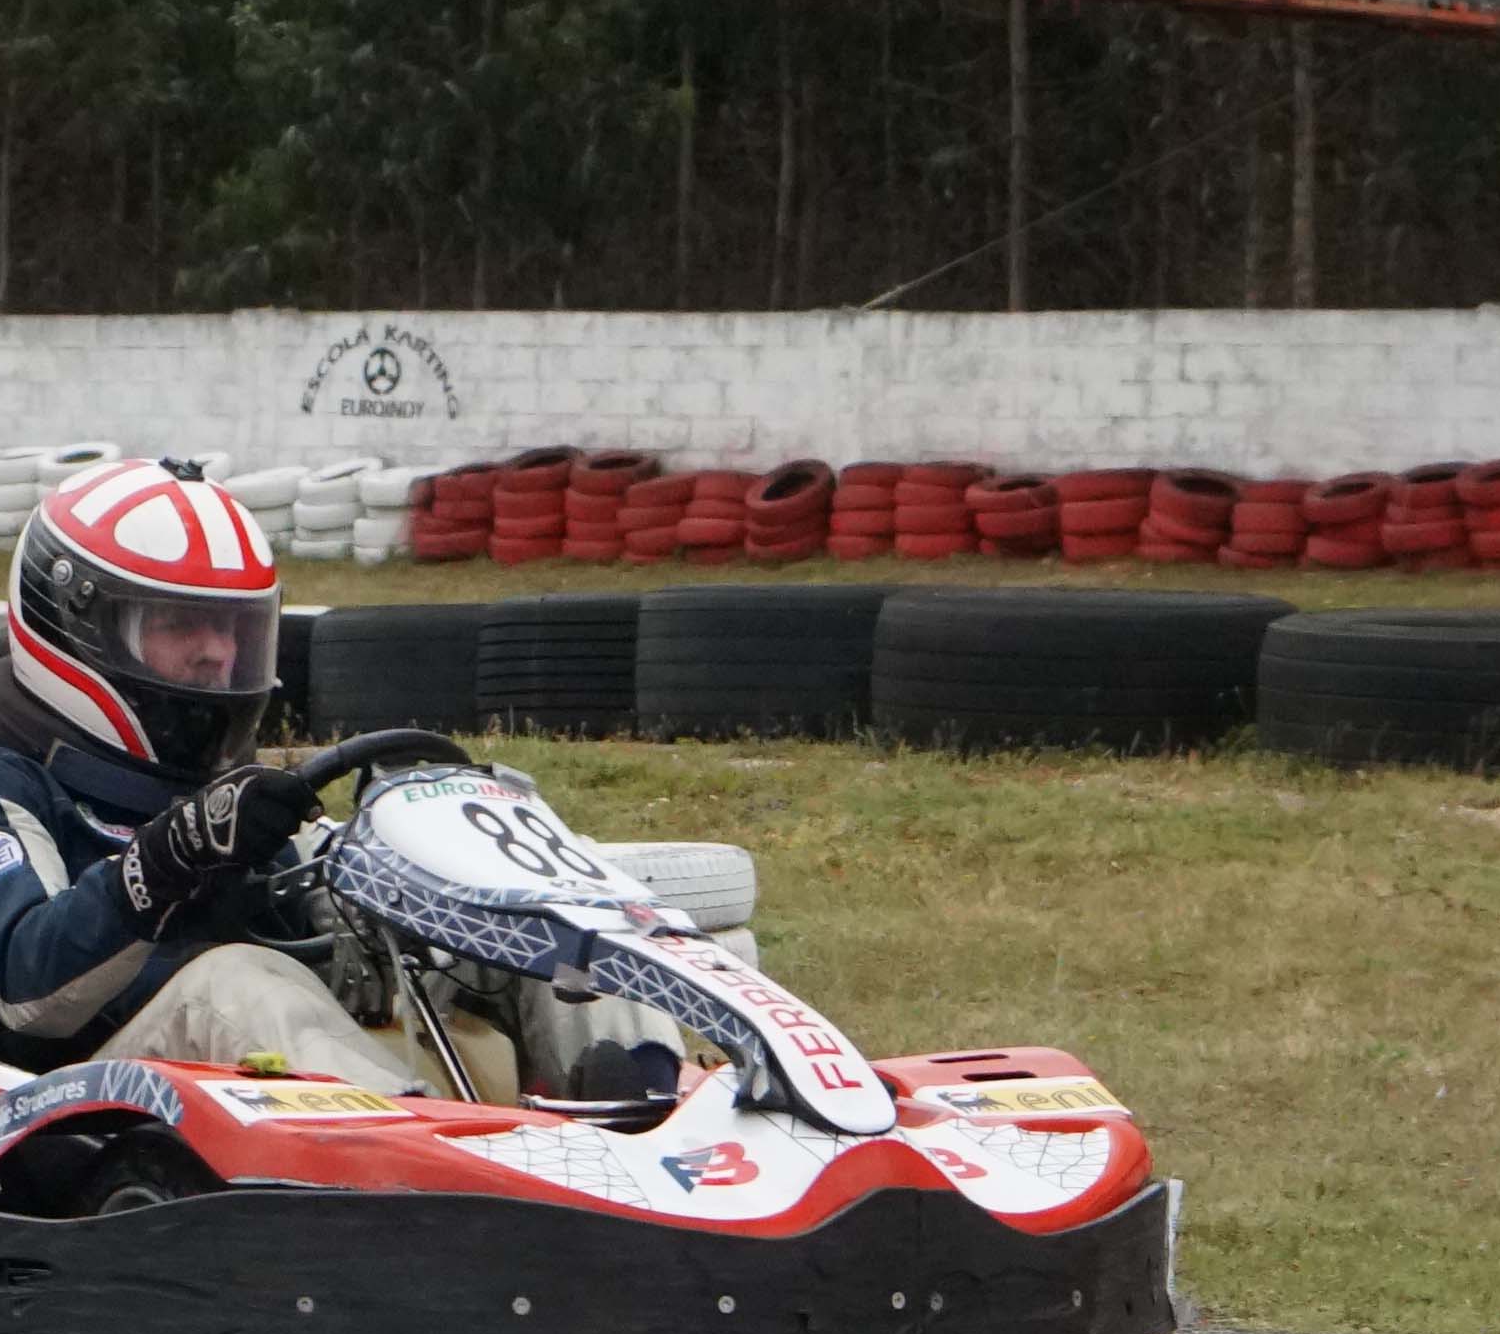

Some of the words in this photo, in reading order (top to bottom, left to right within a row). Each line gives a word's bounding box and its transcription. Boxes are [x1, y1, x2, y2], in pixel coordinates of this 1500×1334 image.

[301, 328, 369, 413] ESCOLA
[384, 323, 458, 420] KARTING
[462, 802, 607, 881] 88
